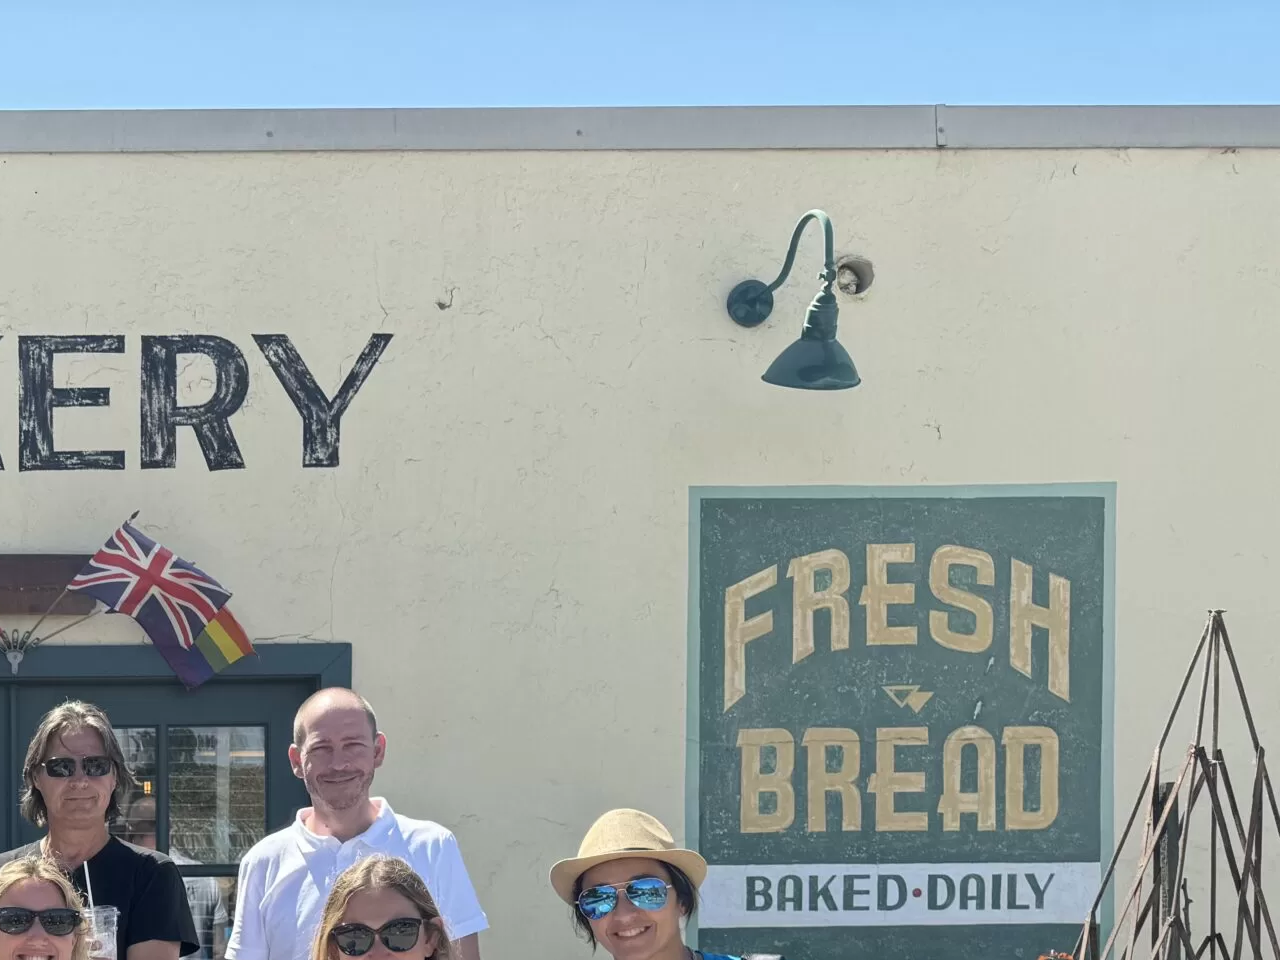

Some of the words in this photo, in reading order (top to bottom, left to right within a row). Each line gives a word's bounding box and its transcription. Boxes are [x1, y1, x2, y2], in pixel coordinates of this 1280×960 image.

[723, 543, 1071, 714] FRESH
[736, 725, 1060, 835] BREAD
[745, 873, 908, 912] BAKED
[927, 873, 1056, 911] DAILY
